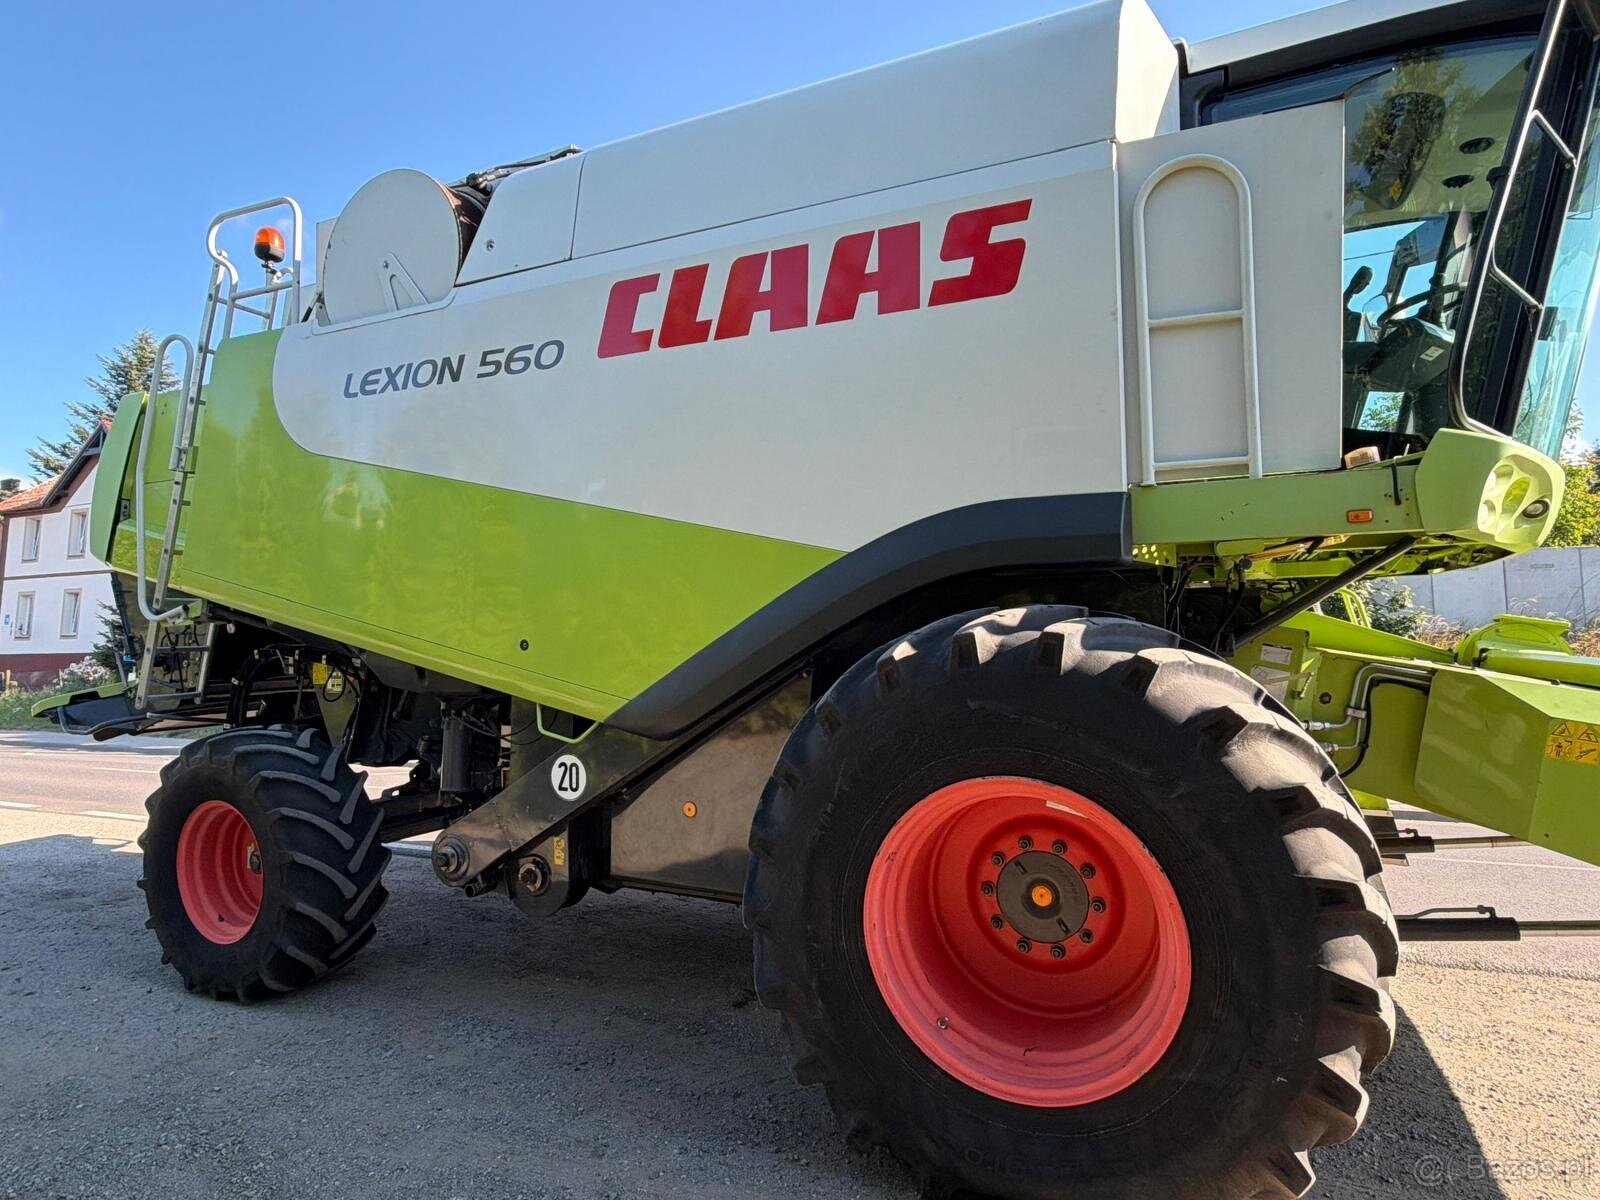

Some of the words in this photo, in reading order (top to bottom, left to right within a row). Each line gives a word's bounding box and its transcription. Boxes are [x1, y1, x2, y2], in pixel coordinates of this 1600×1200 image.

[597, 198, 1033, 359] CLAAS
[343, 354, 466, 399] LEXION
[476, 340, 565, 379] 560
[558, 761, 579, 792] 20
